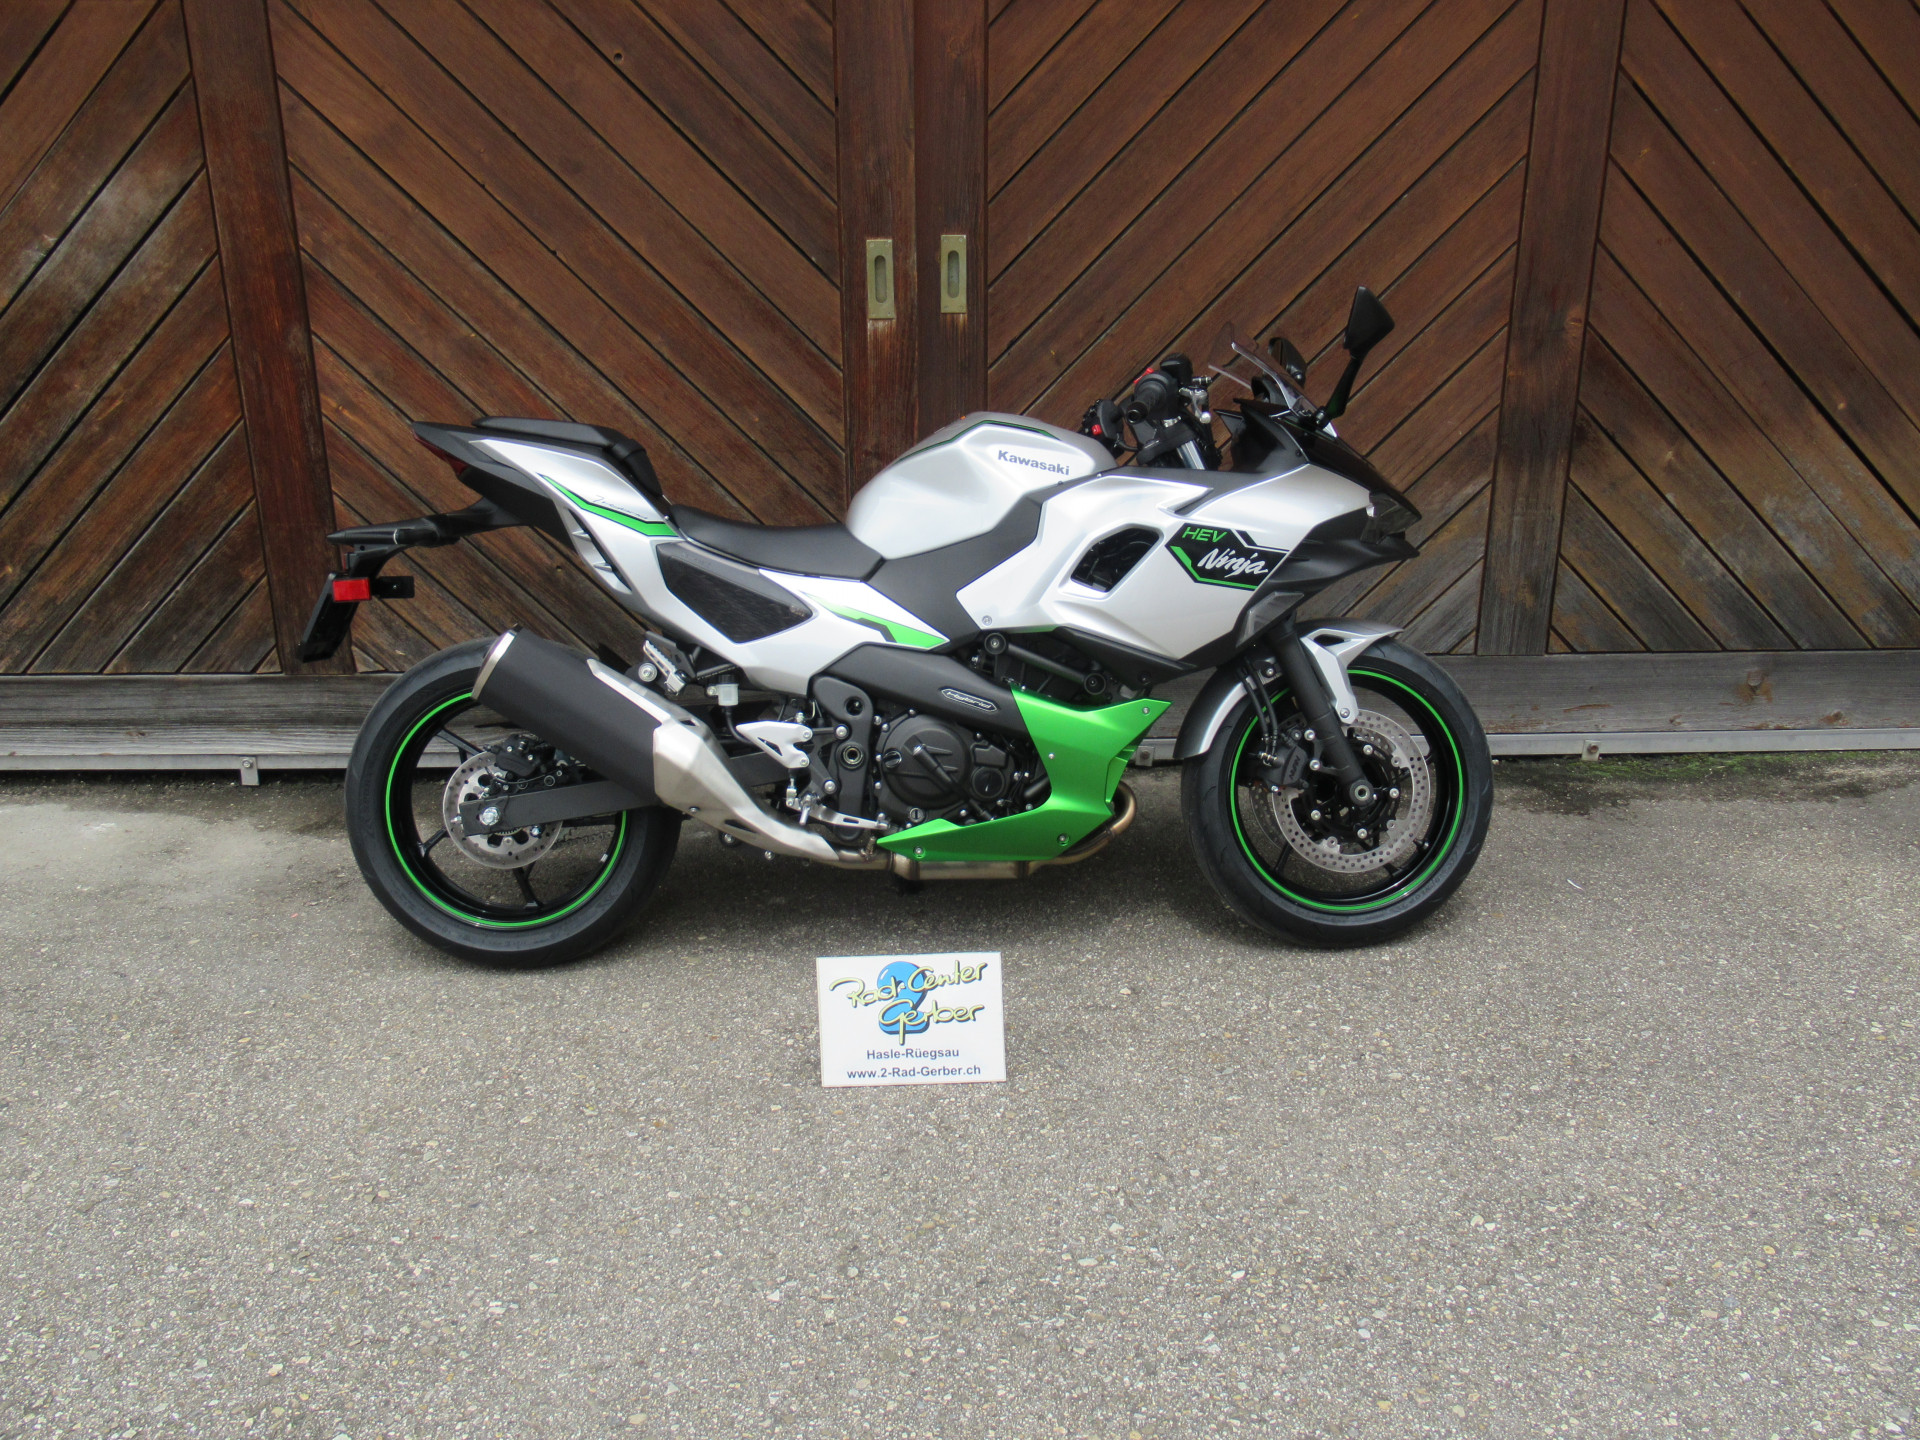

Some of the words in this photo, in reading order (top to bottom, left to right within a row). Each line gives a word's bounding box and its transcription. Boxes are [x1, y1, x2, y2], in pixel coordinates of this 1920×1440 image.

[998, 450, 1070, 476] Kawasaki
[1182, 526, 1228, 543] HEV
[1197, 548, 1268, 578] Ninja
[879, 999, 984, 1046] Gerber
[866, 1048, 960, 1060] Hasle-Rüegsau
[847, 1065, 981, 1079] www.2-Rad-Gerber.ch
